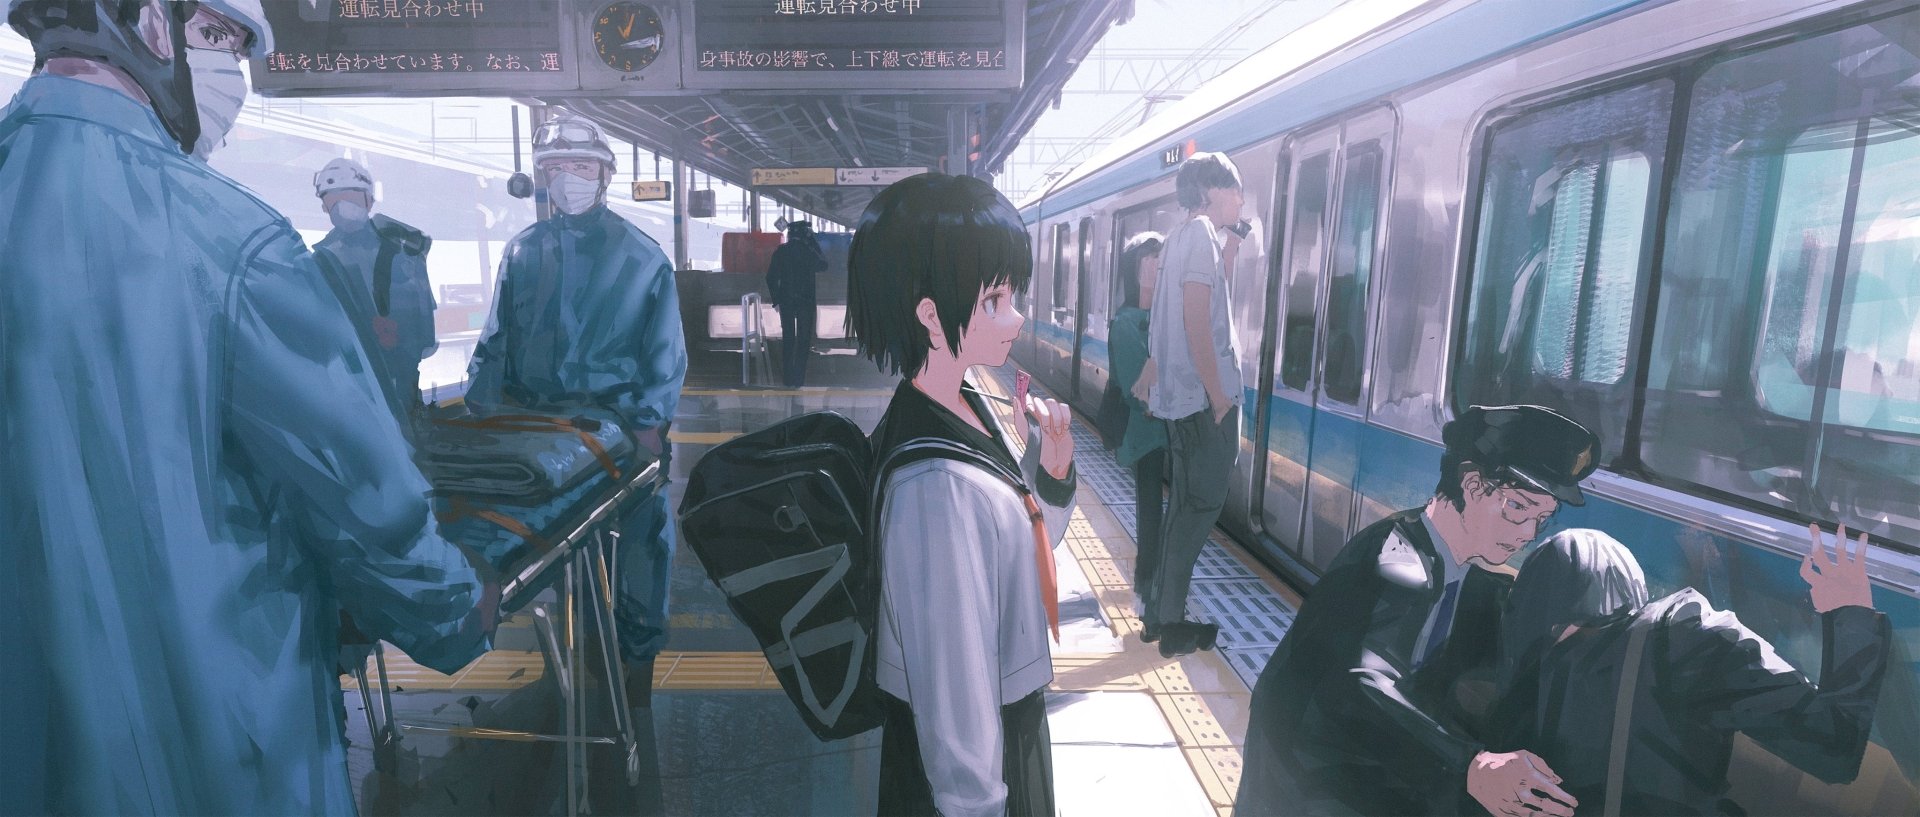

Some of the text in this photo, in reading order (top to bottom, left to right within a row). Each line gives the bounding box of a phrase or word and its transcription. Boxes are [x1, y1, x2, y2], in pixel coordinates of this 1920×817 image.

[339, 0, 484, 19] 運転見合わせ中
[774, 0, 921, 15] 運転見合わせ中
